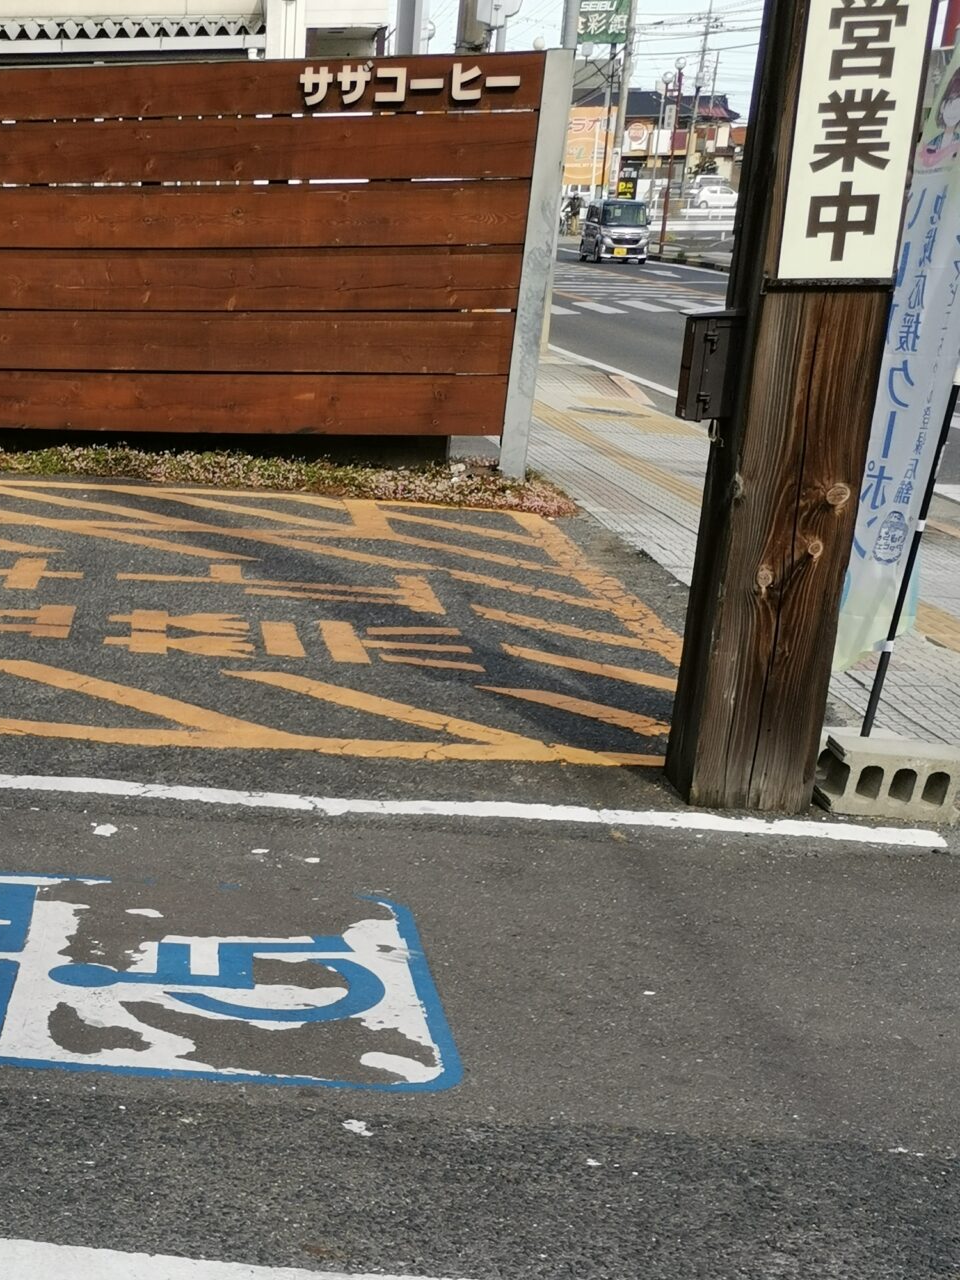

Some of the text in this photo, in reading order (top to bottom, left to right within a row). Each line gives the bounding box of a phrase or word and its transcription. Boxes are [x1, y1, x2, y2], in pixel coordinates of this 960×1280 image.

[300, 60, 520, 106] サザコーヒー
[805, 0, 909, 262] 営業中
